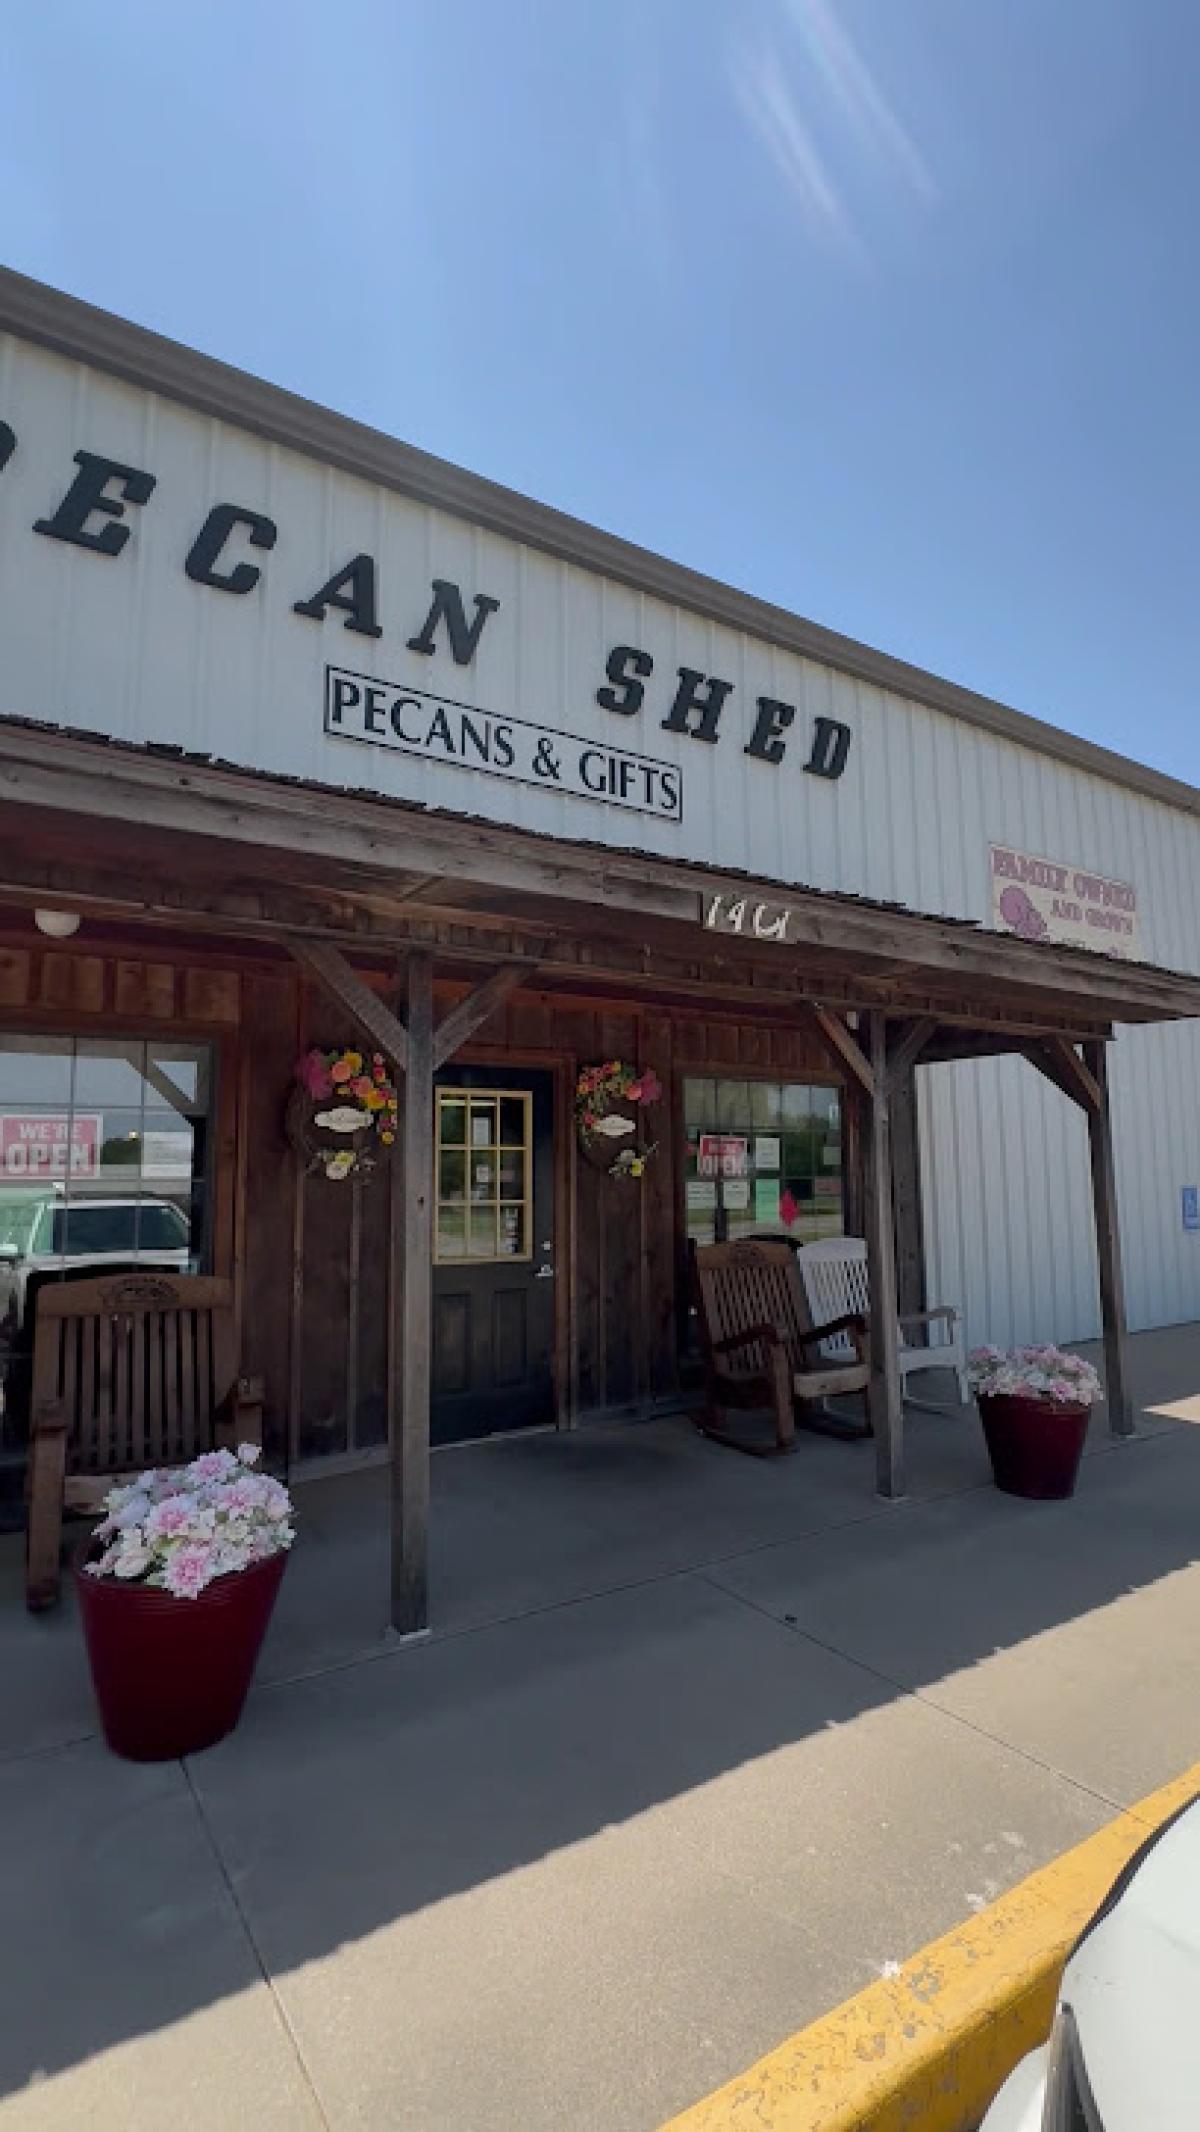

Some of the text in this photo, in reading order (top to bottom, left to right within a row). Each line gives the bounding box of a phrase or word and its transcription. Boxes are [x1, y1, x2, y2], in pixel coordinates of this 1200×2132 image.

[0, 419, 851, 779] ECAN SHED
[331, 678, 678, 810] PECANS & GIFTS
[8, 1143, 89, 1174] OPEN
